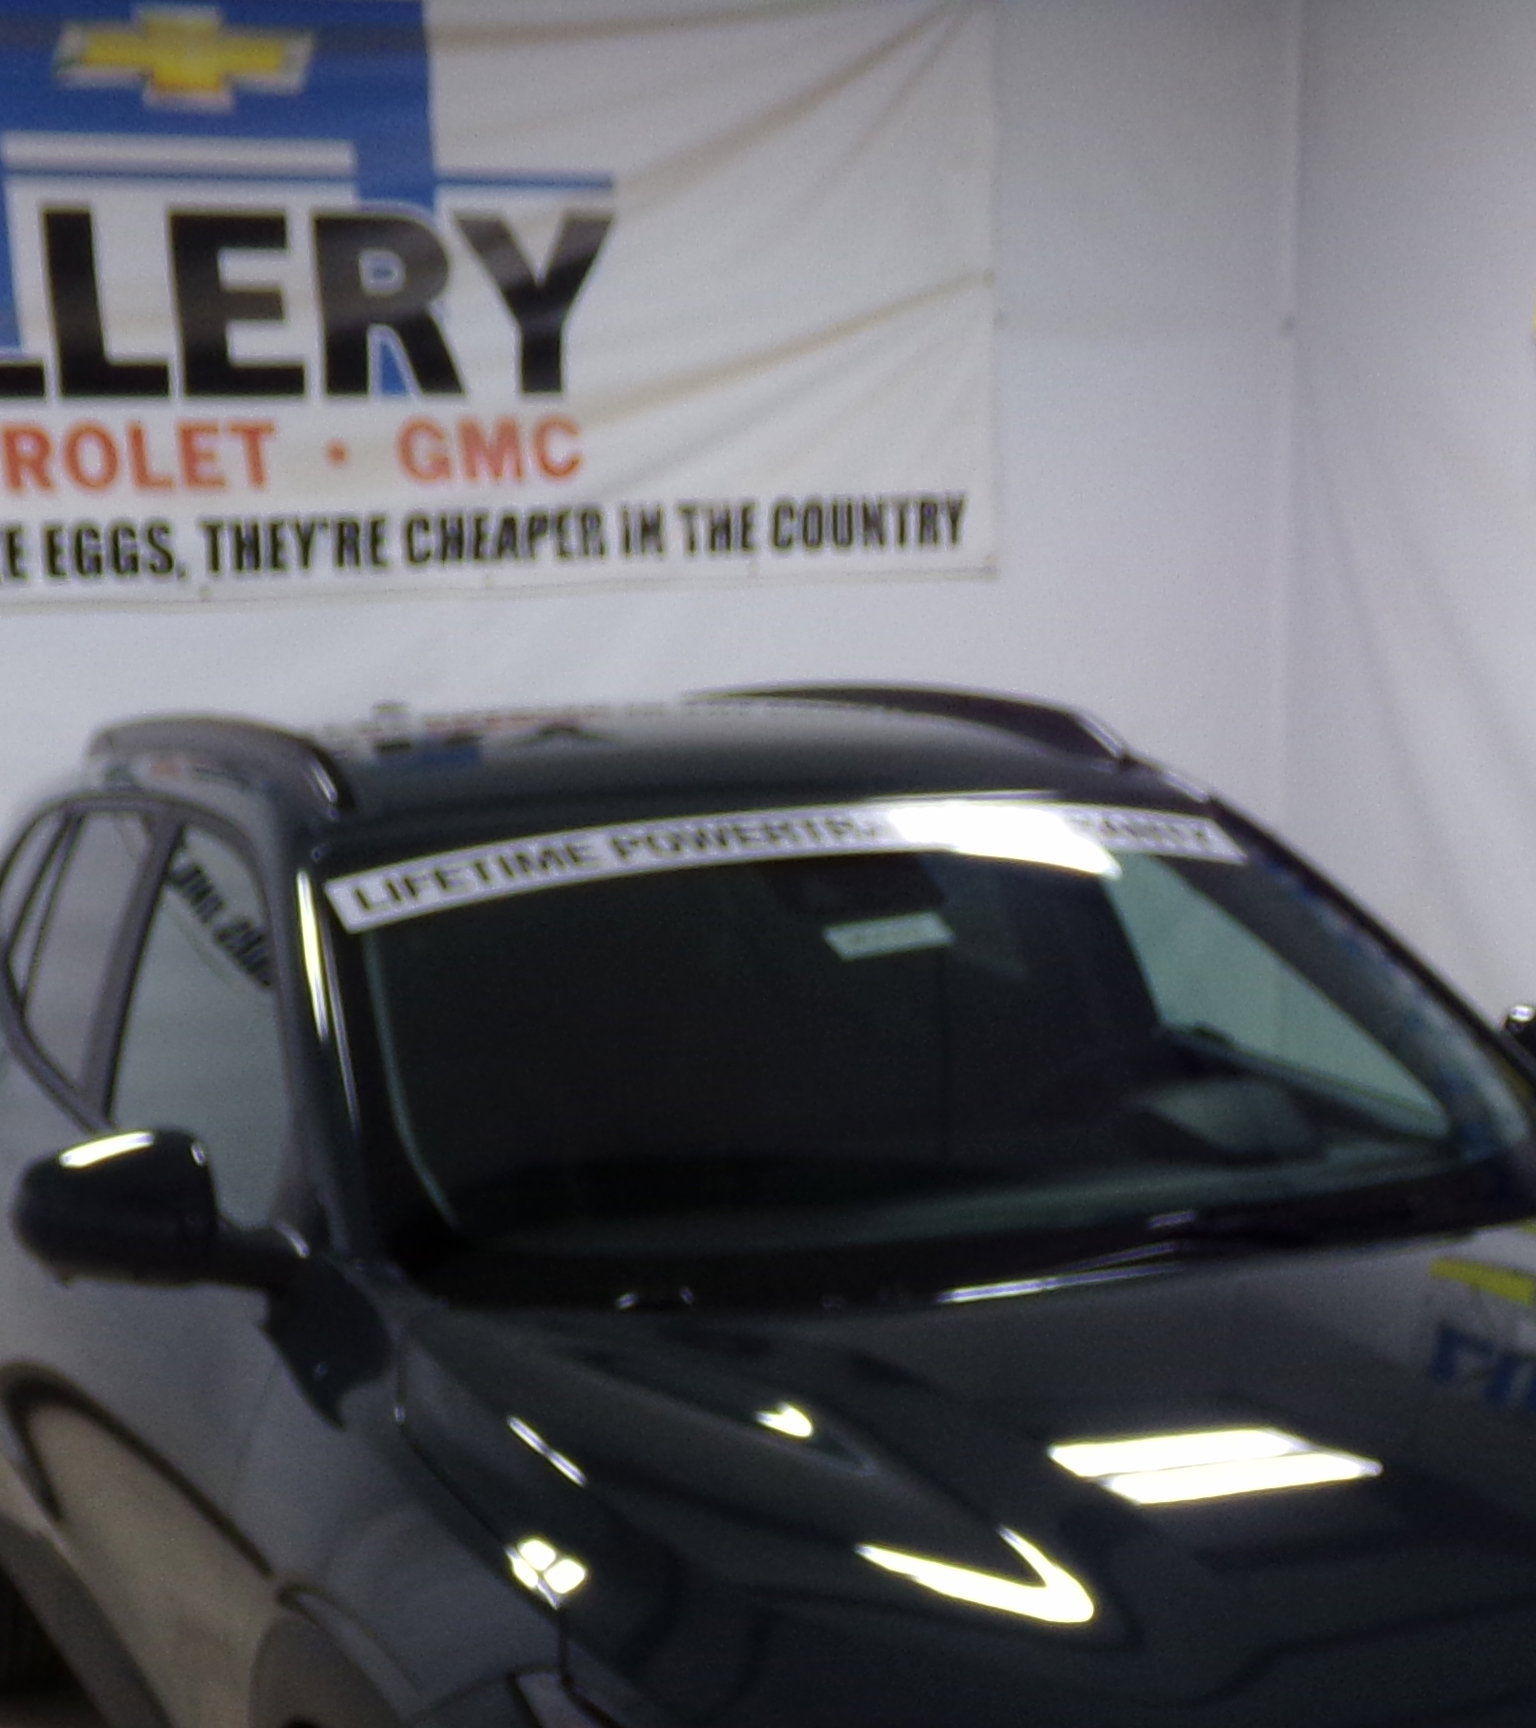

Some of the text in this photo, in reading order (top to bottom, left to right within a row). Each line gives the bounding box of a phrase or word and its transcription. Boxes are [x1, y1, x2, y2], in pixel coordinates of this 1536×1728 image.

[397, 416, 584, 482] GMC
[40, 520, 187, 582] EGGS,
[200, 514, 389, 579] THEY'RE
[401, 506, 608, 569] CHEAPER
[618, 504, 665, 557] IN
[678, 503, 755, 554] THE
[769, 493, 967, 551] COUNTRY
[354, 842, 601, 911] LIFETIME
